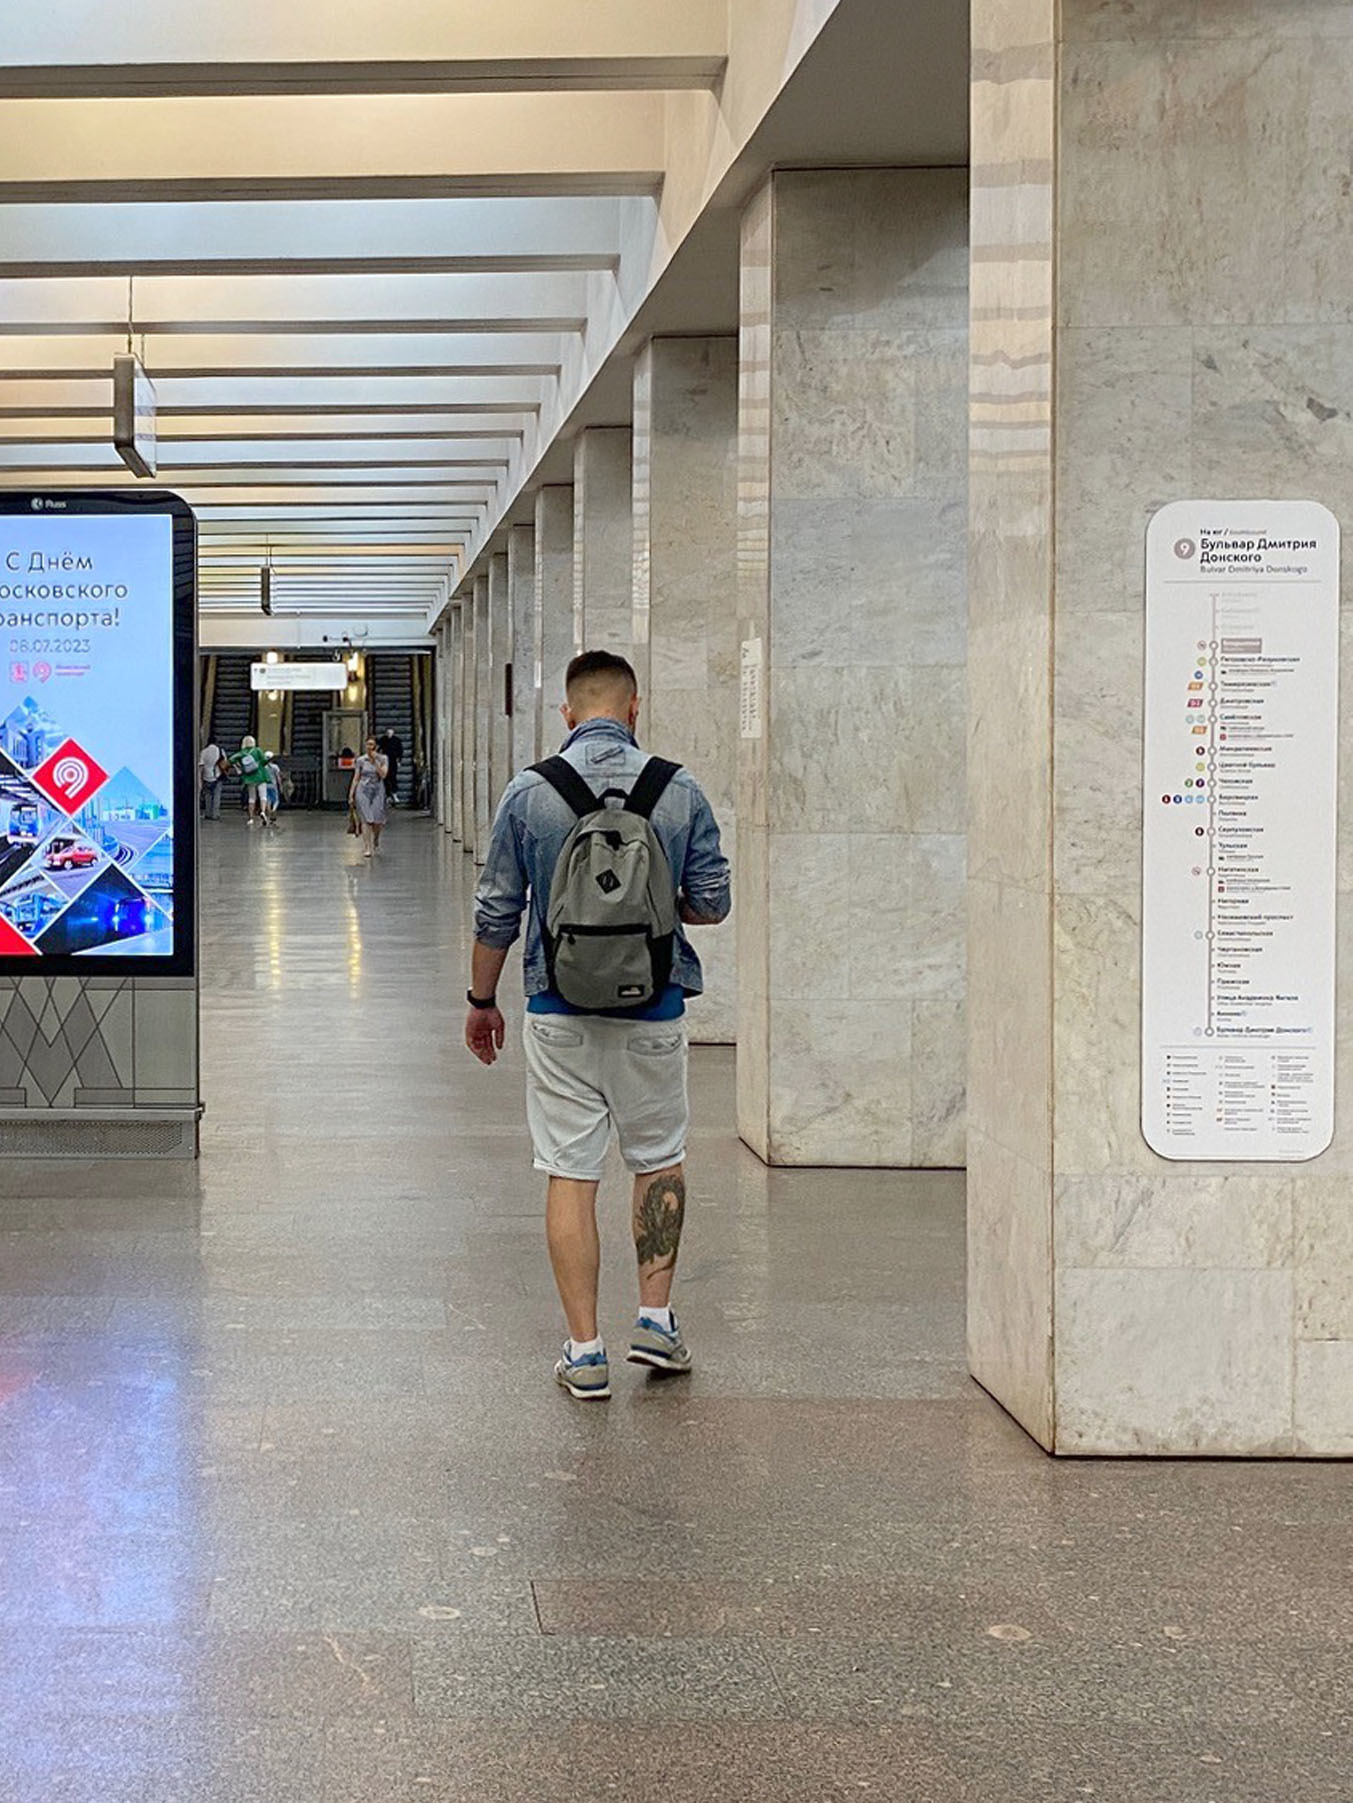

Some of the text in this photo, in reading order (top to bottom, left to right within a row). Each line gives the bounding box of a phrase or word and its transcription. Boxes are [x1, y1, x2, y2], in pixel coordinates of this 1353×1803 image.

[1200, 538, 1317, 551] Бульвар Дмитрия
[5, 552, 94, 573] С Днём
[1200, 551, 1262, 564] Донского
